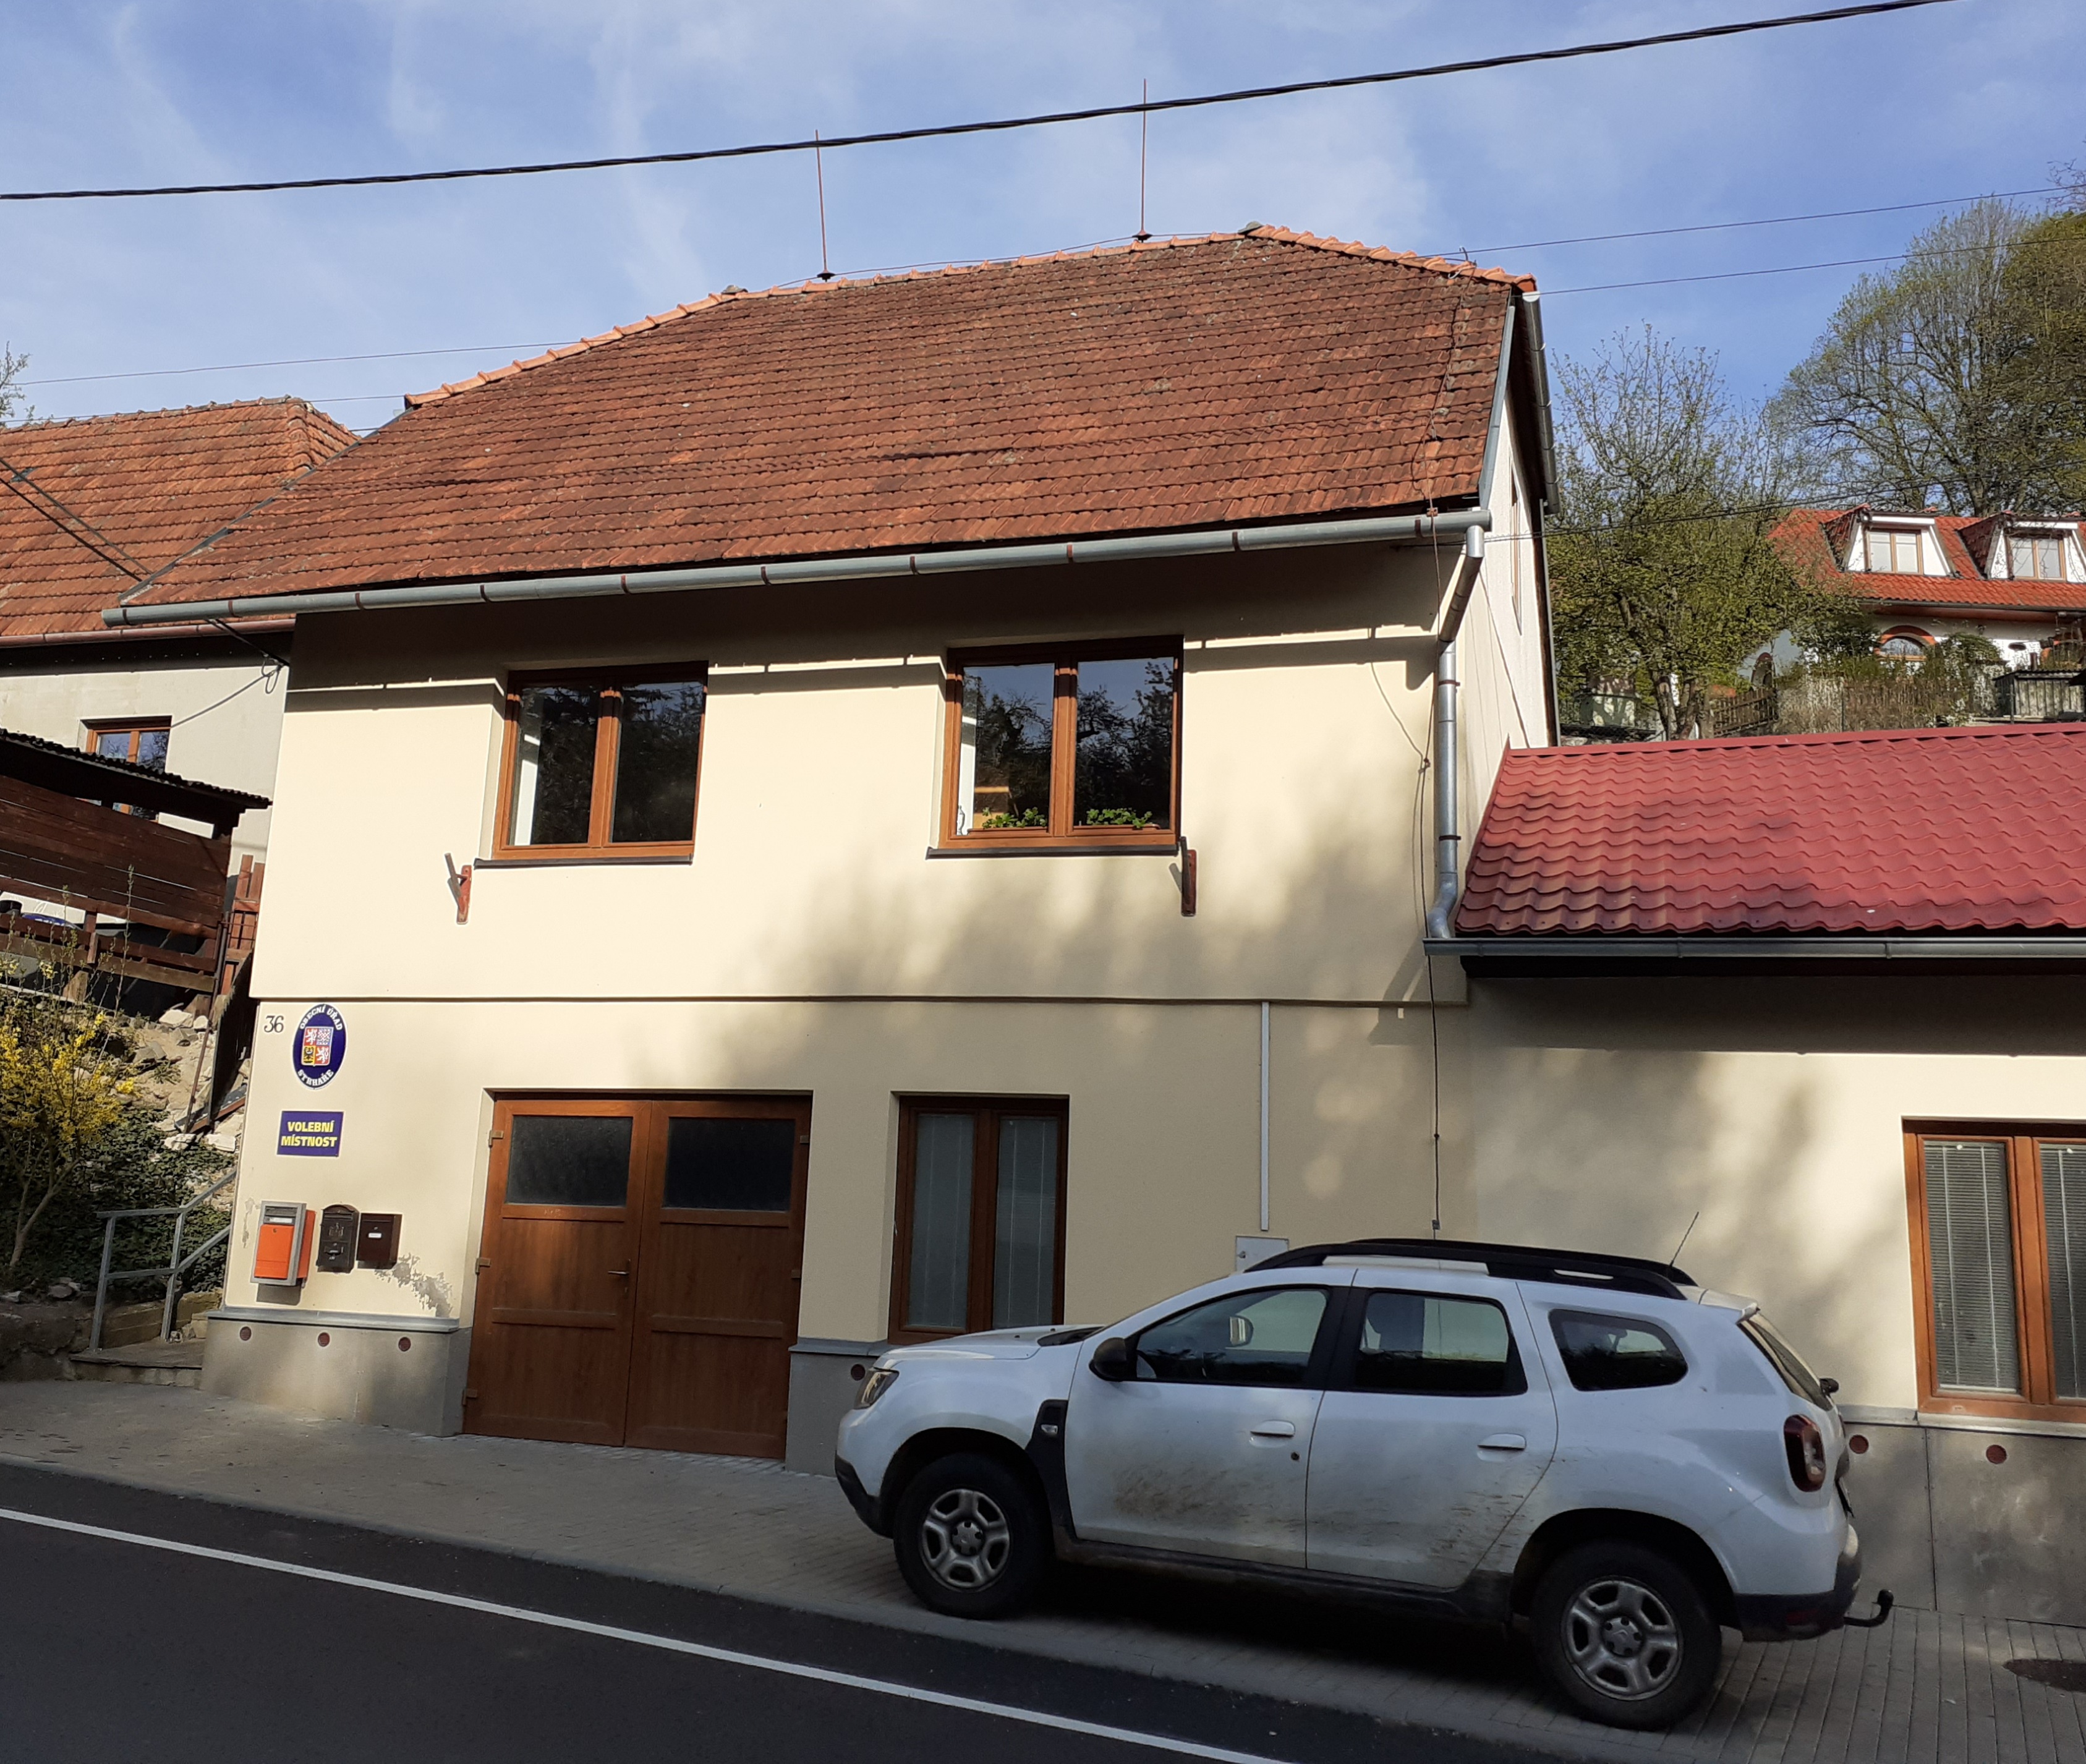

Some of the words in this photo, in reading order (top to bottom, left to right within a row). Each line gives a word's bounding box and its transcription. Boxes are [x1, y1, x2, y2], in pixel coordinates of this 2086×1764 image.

[264, 1015, 284, 1033] 36
[299, 1004, 326, 1029] OBECNÍ
[326, 1007, 343, 1030] ÚŘAD
[287, 1120, 334, 1132] VOLEBNÍ
[281, 1134, 338, 1147] MÍSTNOST
